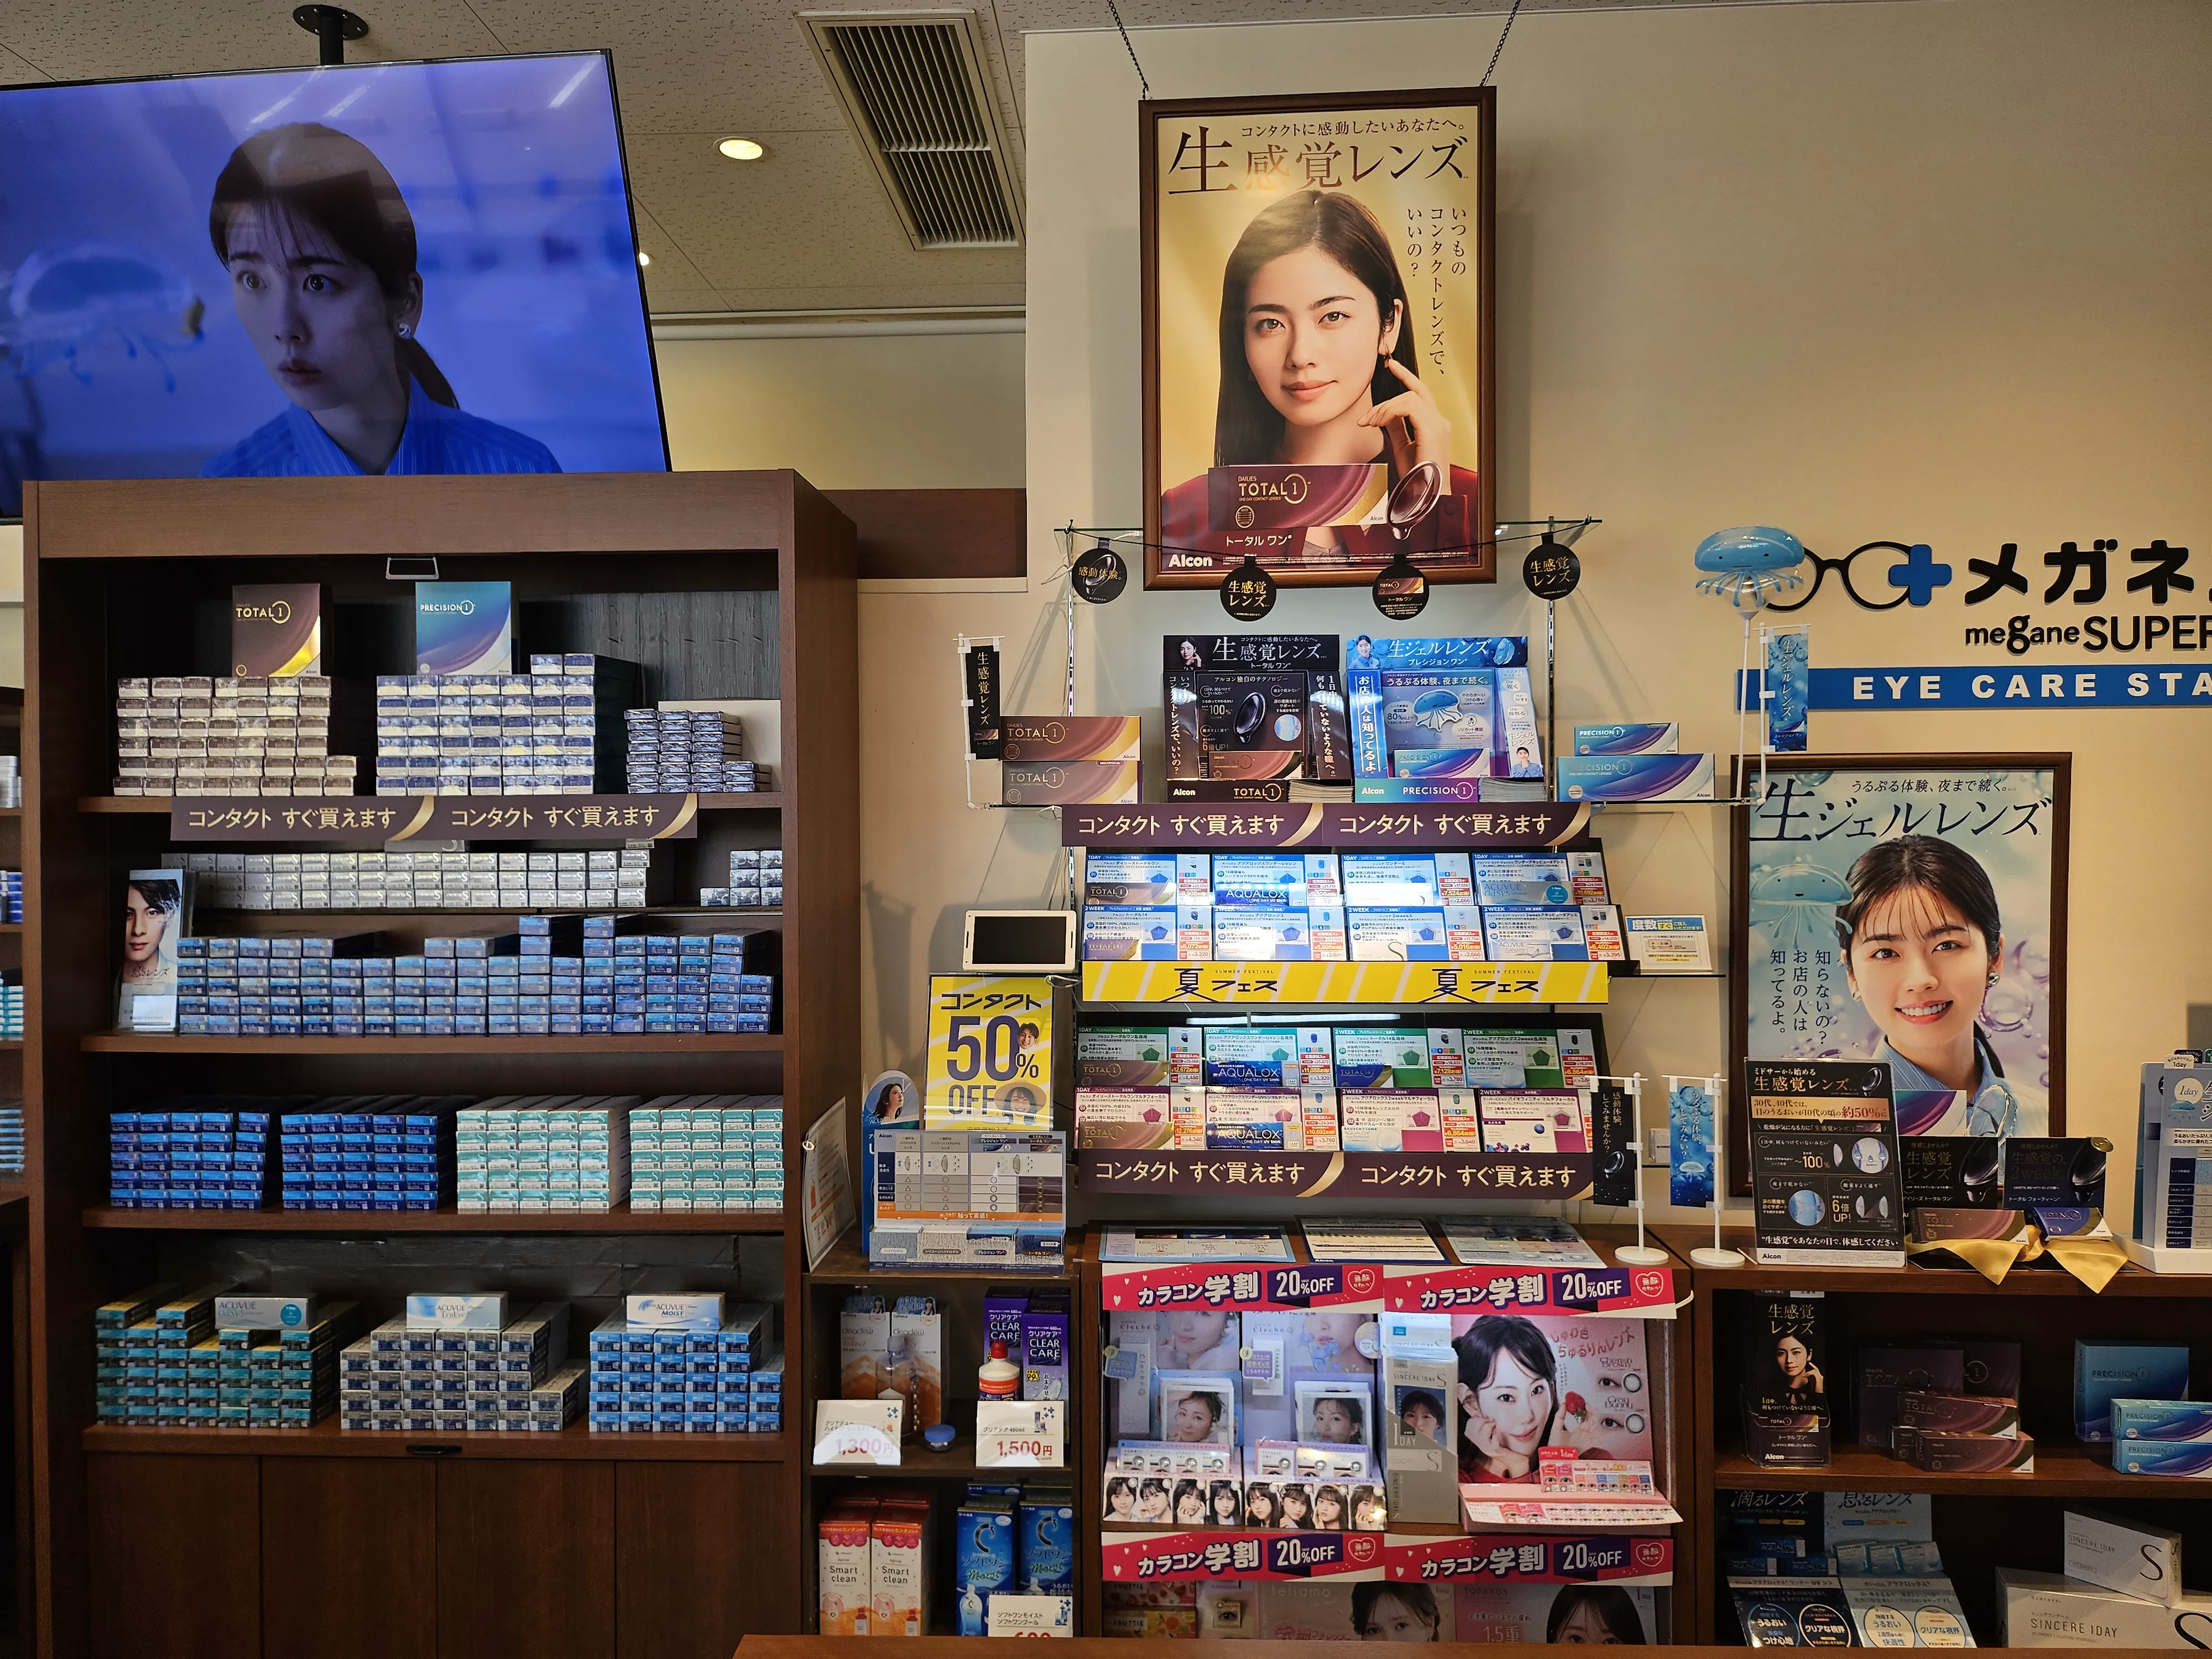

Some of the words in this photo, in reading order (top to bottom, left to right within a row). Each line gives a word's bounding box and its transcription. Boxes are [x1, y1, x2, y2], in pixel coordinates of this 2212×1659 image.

[1241, 118, 1464, 137] コンタクトに感動したいあなたへ。
[1168, 126, 1469, 195] 生感覚レンズ
[1407, 208, 1422, 277] いいの？
[1451, 207, 1465, 275] いつもの
[1430, 208, 1445, 375] コンタクトレンズで、
[1226, 537, 1265, 546] トータル
[1168, 555, 1213, 568] Alcon
[1530, 557, 1569, 573] 生感覚
[1078, 566, 1123, 580] 感動体験。
[1533, 572, 1571, 586] レンズ
[1965, 538, 2212, 606] メガネ
[1228, 581, 1266, 594] 生感覚
[1229, 594, 1265, 607] レンズ
[1212, 637, 1321, 661] 生感覚レンズ
[1387, 639, 1492, 658] 生ジェルレンズ
[1387, 677, 1489, 686] うるぷる体験、夜まで続く。
[1781, 639, 1794, 718] 生ジェルレンズ
[1854, 675, 1941, 700] EYE
[1971, 673, 2096, 699] CARE
[977, 651, 990, 726] 生感覚レンズ
[1358, 676, 1376, 771] お店の人は知ってるよ
[1509, 731, 1535, 740] 生ジェル
[1853, 779, 2008, 794] うるぷる体験、夜まで続く。
[189, 809, 272, 829] コンタクト
[282, 807, 397, 829] すぐ買えます
[451, 807, 533, 828] コンタクト
[544, 805, 659, 828] すぐ買えます
[1749, 779, 2052, 842] 生ジェルレンズ
[1078, 816, 1160, 836] コンタクト
[1170, 814, 1284, 836] すぐ買えます
[1339, 816, 1423, 835] コンタクト
[1434, 813, 1552, 836] すぐ買えます
[608, 852, 615, 863] S
[641, 851, 647, 860] S
[638, 868, 644, 879] S
[1226, 890, 1285, 898] AQUALOX
[1632, 920, 1657, 930] 度数
[1770, 950, 1786, 1035] 知ってるよ。
[1793, 950, 1808, 1032] お店の人は
[1814, 950, 1831, 1044] 知らないの？
[941, 994, 1041, 1010] コンタクト
[947, 1015, 1039, 1081] 50%
[1218, 1068, 1279, 1077] AQUALOX
[1754, 1076, 1849, 1092] 生感覚レンズ
[2179, 1086, 2198, 1097] 1day
[948, 1084, 996, 1115] OFF
[1613, 1092, 1622, 1126] 感動体験、
[1602, 1094, 1611, 1153] してみませんか？
[1217, 1130, 1280, 1139] AQUALOX
[1679, 1109, 1689, 1160] してみない？
[1906, 1151, 1952, 1166] 生感覚
[1095, 1161, 1179, 1183] コンタクト
[1189, 1161, 1305, 1184] すぐ買えます
[1361, 1165, 1447, 1187] コンタクト
[1457, 1165, 1576, 1188] すぐ買えます
[1907, 1166, 1952, 1181] レンズ
[1138, 1271, 1259, 1306] カラコン学割
[1420, 1273, 1545, 1310] カラコン学割
[219, 1301, 257, 1310] ACUVUE
[1768, 1303, 1814, 1319] 生感覚
[991, 1322, 1020, 1331] CLEAR
[1770, 1321, 1815, 1336] レンズ
[991, 1331, 1020, 1340] CARE
[1030, 1339, 1060, 1348] CLEAR
[1030, 1349, 1061, 1358] CARE
[997, 1441, 1052, 1457] 1,500円
[1138, 1540, 1259, 1577] カラコン学割
[1421, 1544, 1545, 1579] カラコン学割
[2140, 1545, 2163, 1581] S
[830, 1565, 858, 1575] Smart
[881, 1566, 910, 1575] Smart
[831, 1574, 857, 1583] clean
[883, 1575, 908, 1584] clean
[2031, 1618, 2084, 1634] SINCERE
